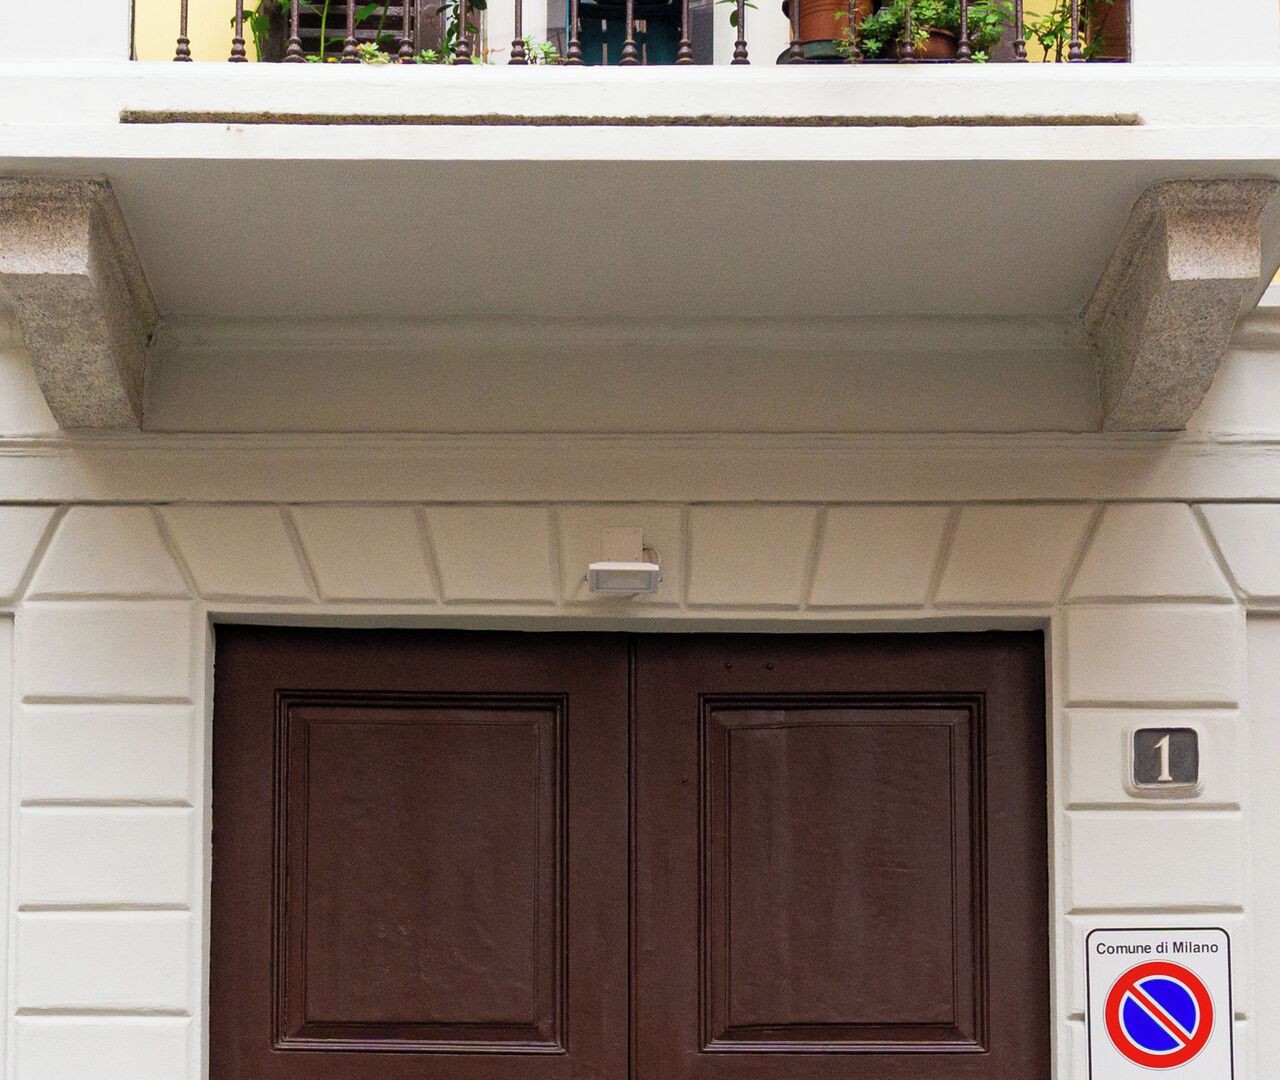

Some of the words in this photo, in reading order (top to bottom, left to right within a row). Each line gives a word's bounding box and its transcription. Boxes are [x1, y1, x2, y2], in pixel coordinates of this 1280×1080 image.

[1153, 734, 1173, 781] 1
[1096, 942, 1152, 955] Comune
[1156, 941, 1168, 954] di
[1172, 941, 1219, 954] Milano
